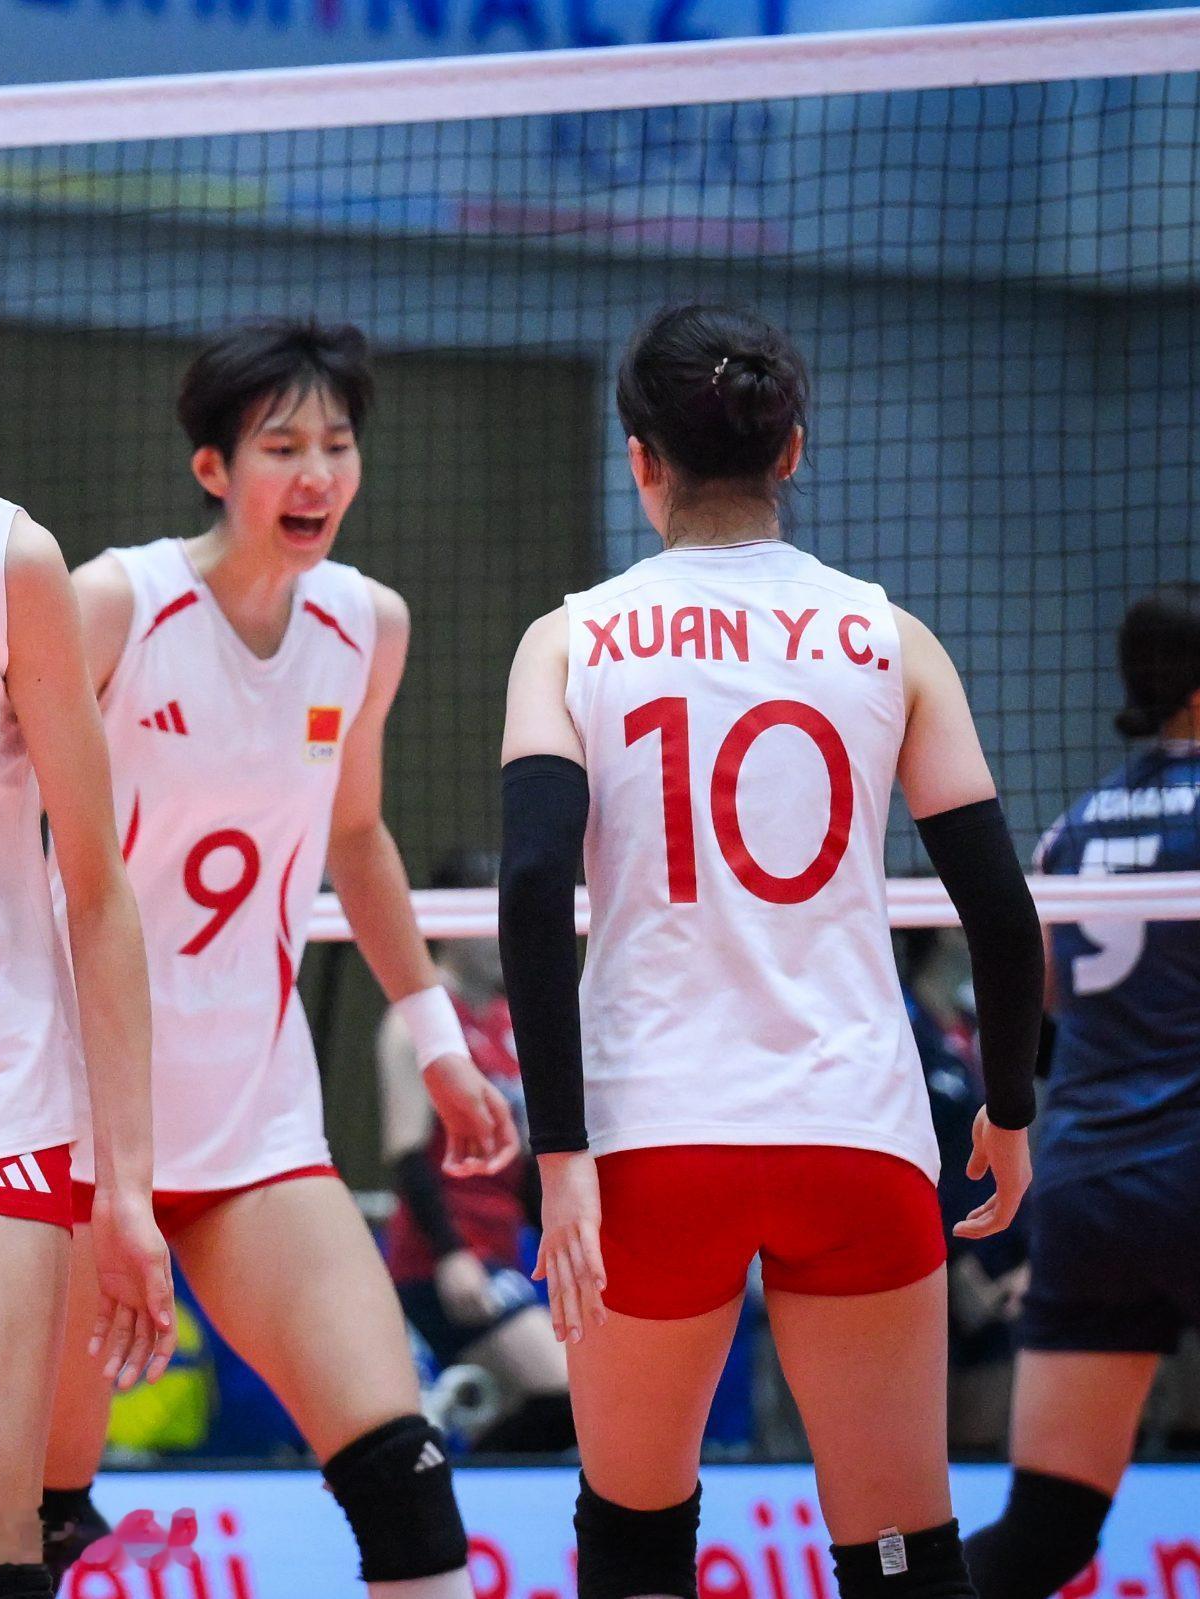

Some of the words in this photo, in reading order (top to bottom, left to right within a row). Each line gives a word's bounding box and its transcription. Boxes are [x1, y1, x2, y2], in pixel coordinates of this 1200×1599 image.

[582, 604, 749, 667] XUAN
[772, 608, 889, 670] Y.C.
[623, 696, 854, 905] 10
[177, 827, 261, 957] 9
